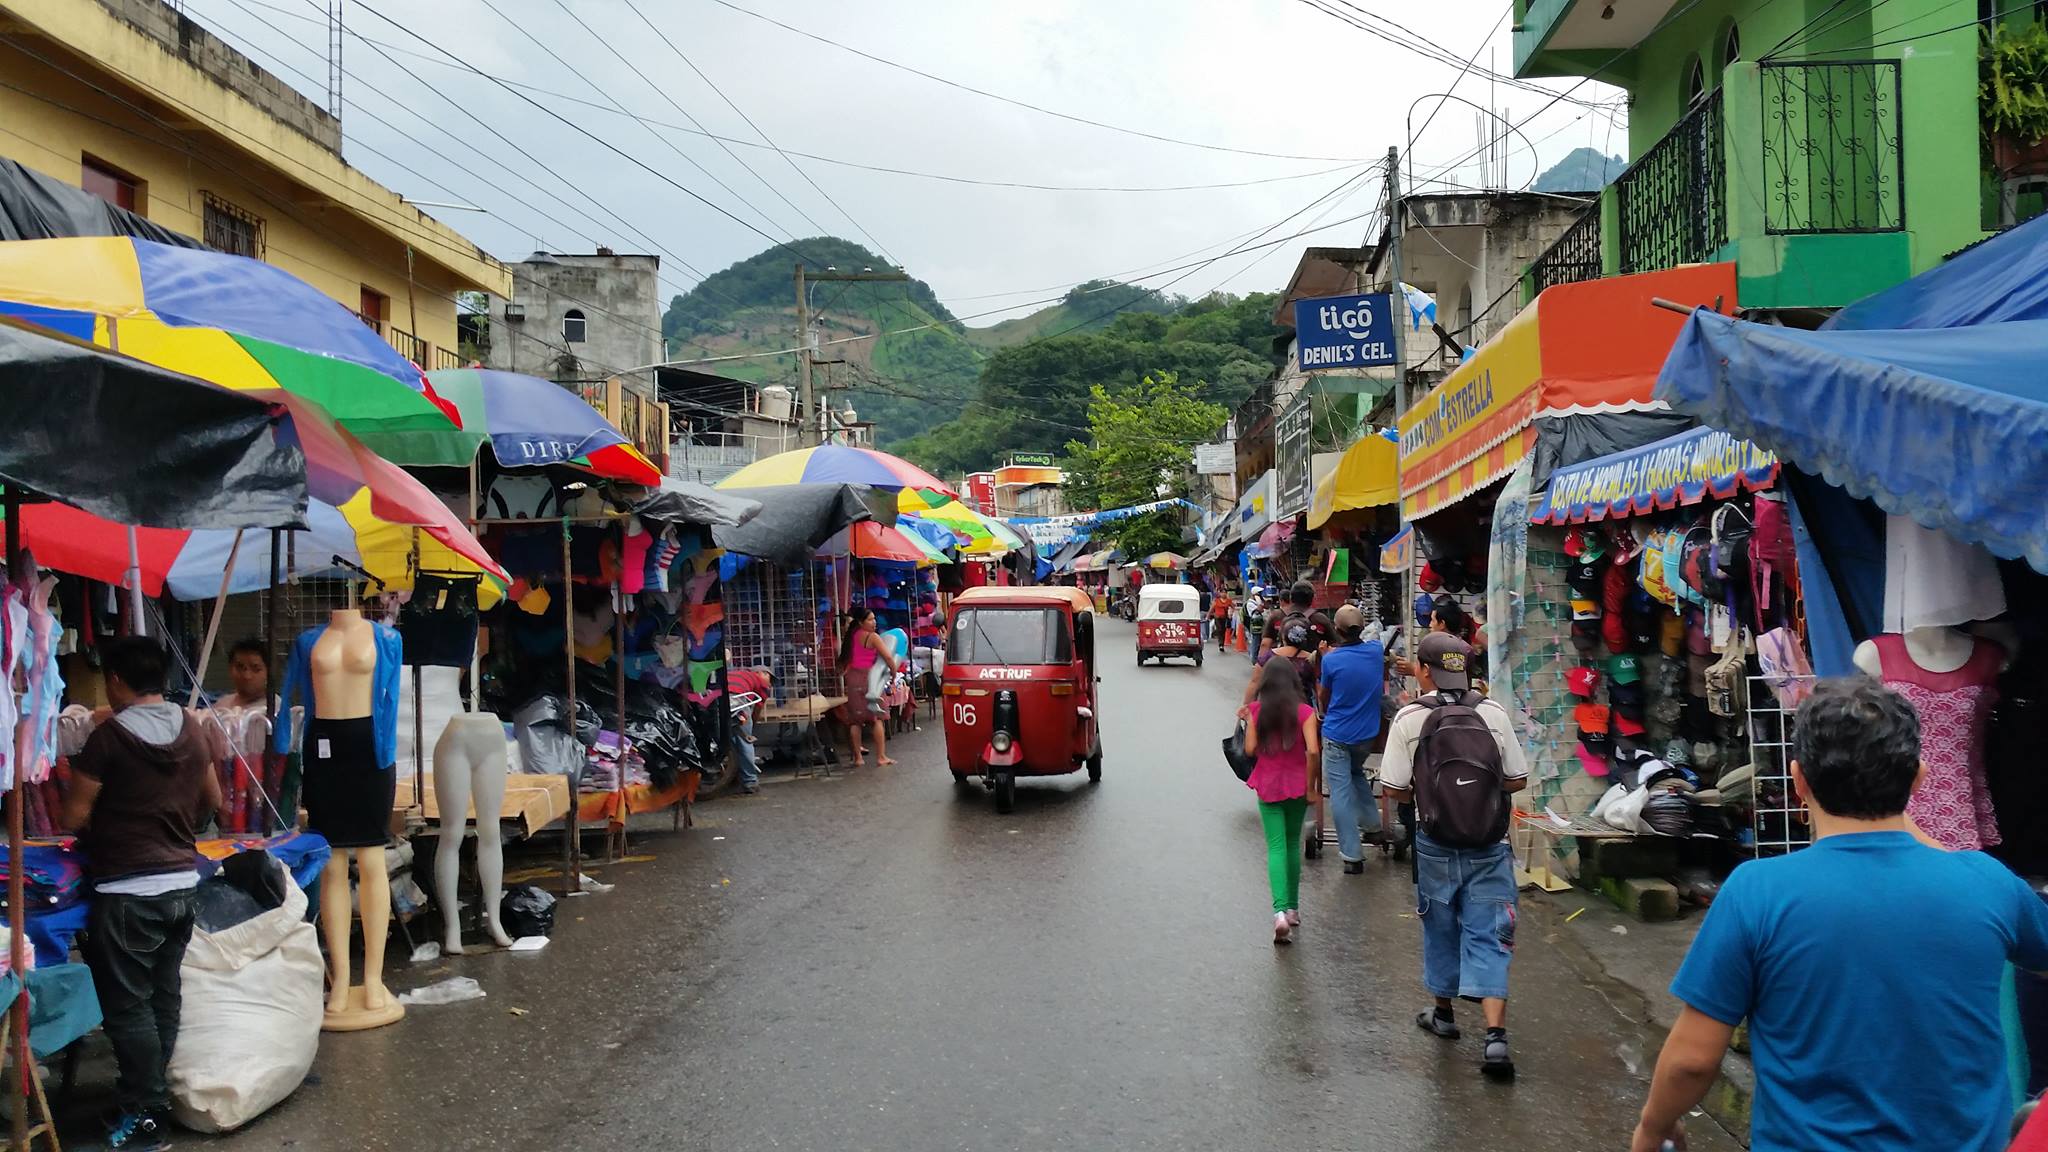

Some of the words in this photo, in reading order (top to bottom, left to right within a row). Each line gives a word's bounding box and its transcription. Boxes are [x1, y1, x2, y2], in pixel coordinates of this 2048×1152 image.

[1320, 303, 1373, 331] tigo
[1303, 345, 1355, 364] DENIL'S
[1361, 342, 1392, 360] CEL.
[1446, 368, 1493, 433] ESTRELLA
[979, 668, 1032, 679] ACTRUF
[953, 703, 977, 726] 06
